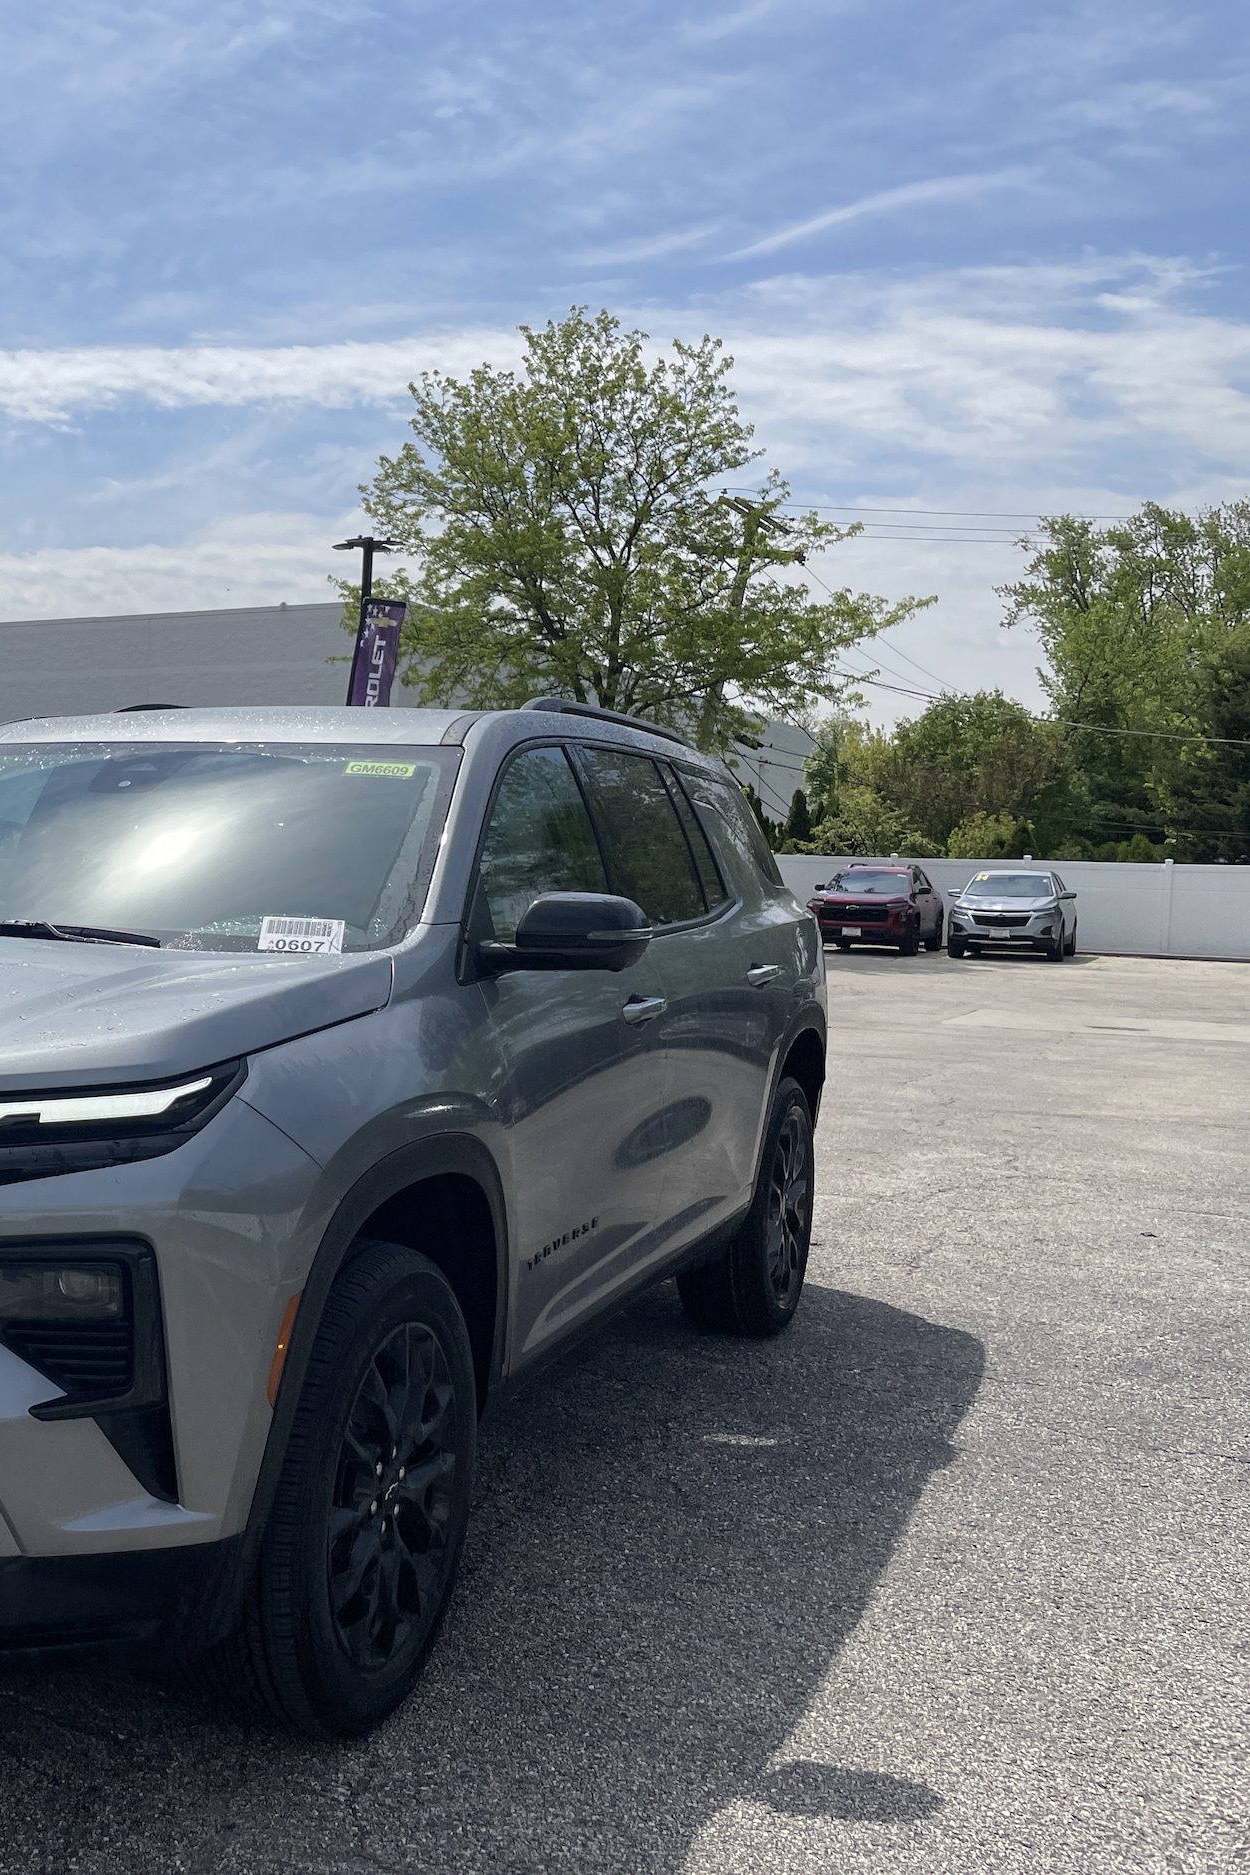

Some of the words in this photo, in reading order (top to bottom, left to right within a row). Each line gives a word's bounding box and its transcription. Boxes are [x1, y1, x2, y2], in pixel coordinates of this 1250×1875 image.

[350, 763, 410, 776] GM6609
[275, 939, 325, 952] 0607
[526, 1216, 600, 1271] TRAVERSE
